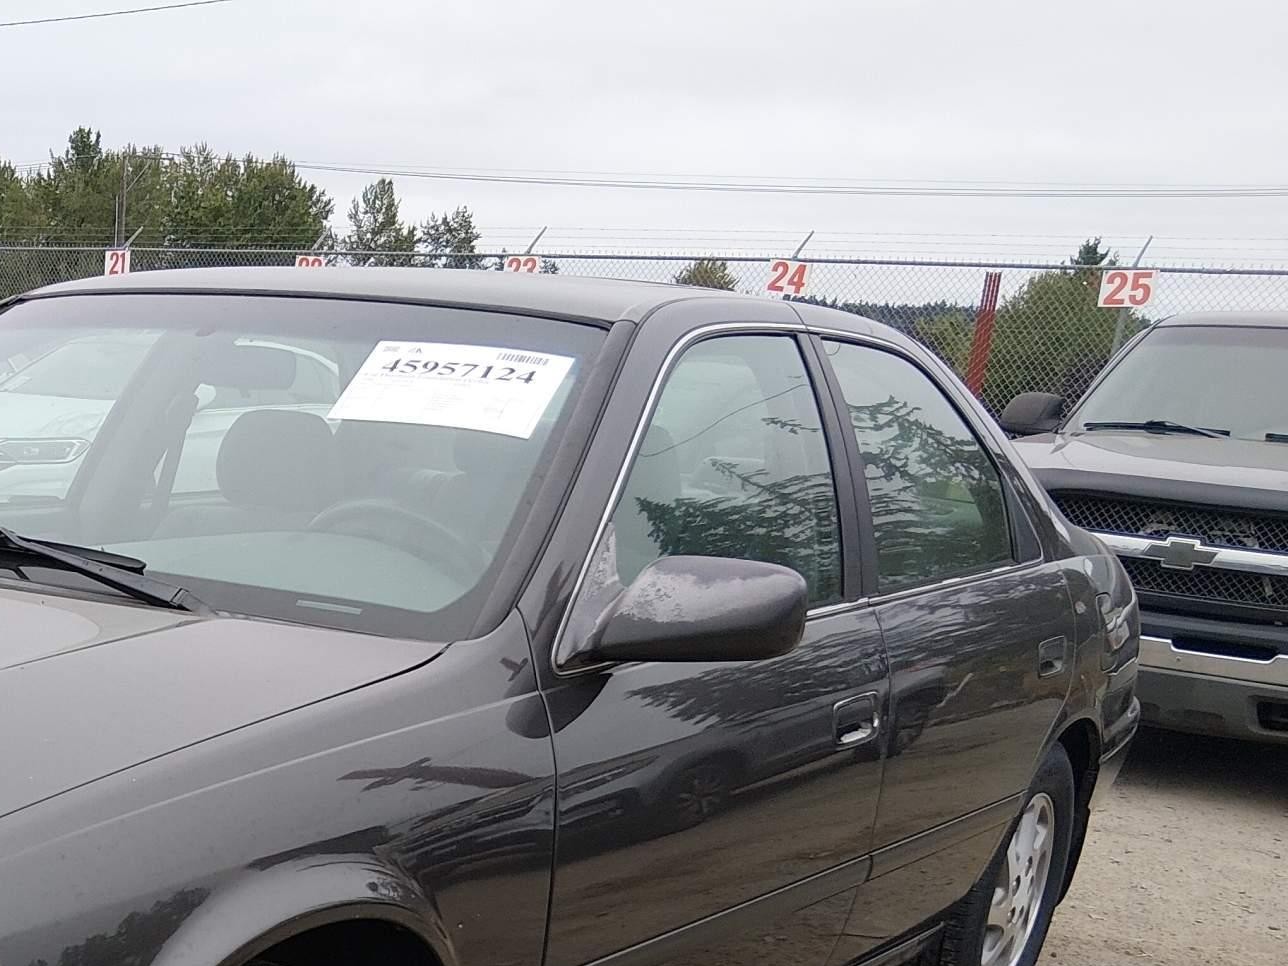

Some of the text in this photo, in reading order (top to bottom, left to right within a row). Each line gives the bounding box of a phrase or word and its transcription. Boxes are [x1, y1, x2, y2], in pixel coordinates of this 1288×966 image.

[108, 252, 126, 275] 21
[767, 261, 807, 294] 24
[1103, 271, 1153, 305] 25
[382, 358, 537, 384] 45957124
